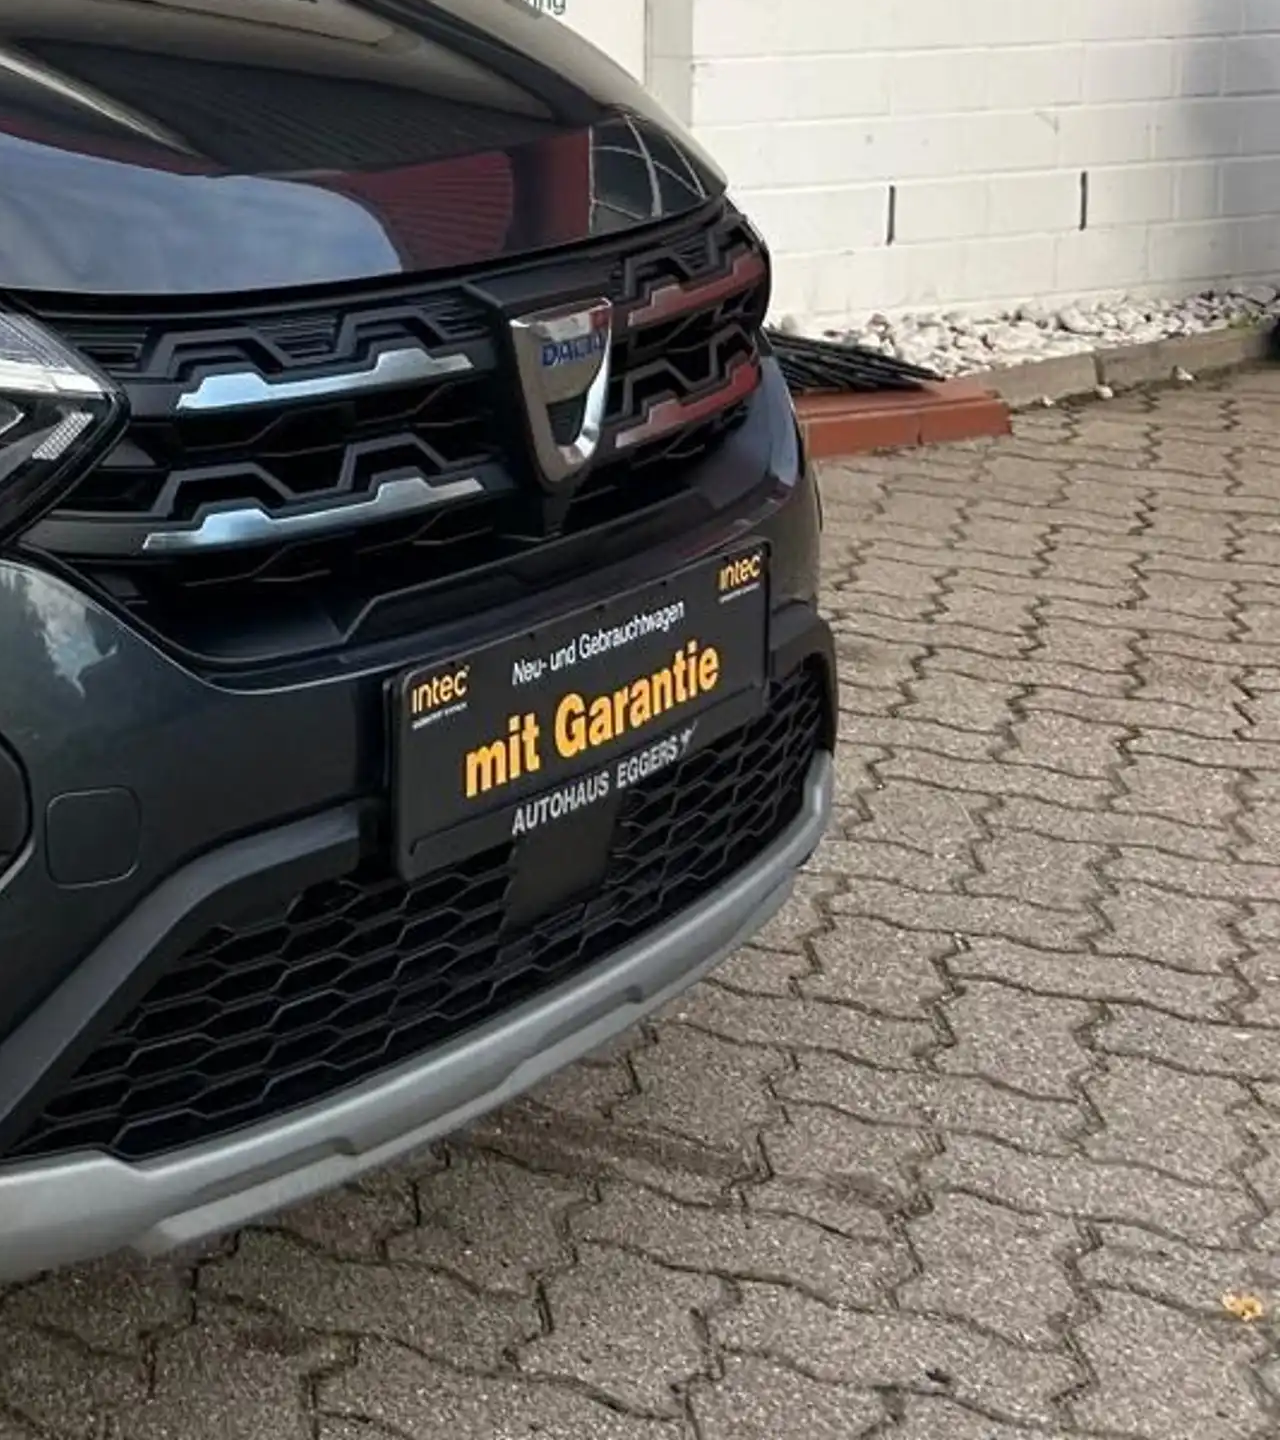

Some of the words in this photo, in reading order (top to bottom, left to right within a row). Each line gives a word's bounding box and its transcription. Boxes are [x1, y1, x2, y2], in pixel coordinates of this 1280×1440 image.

[718, 553, 761, 592] intec
[512, 658, 547, 686] Neu-
[550, 639, 576, 672] und
[578, 600, 685, 659] Gebrauchtwagen
[412, 669, 469, 715] intec
[463, 711, 541, 798] mit
[554, 638, 720, 759] Garantie
[512, 770, 610, 836] AUTOHAUS
[616, 734, 679, 789] EGGERS
